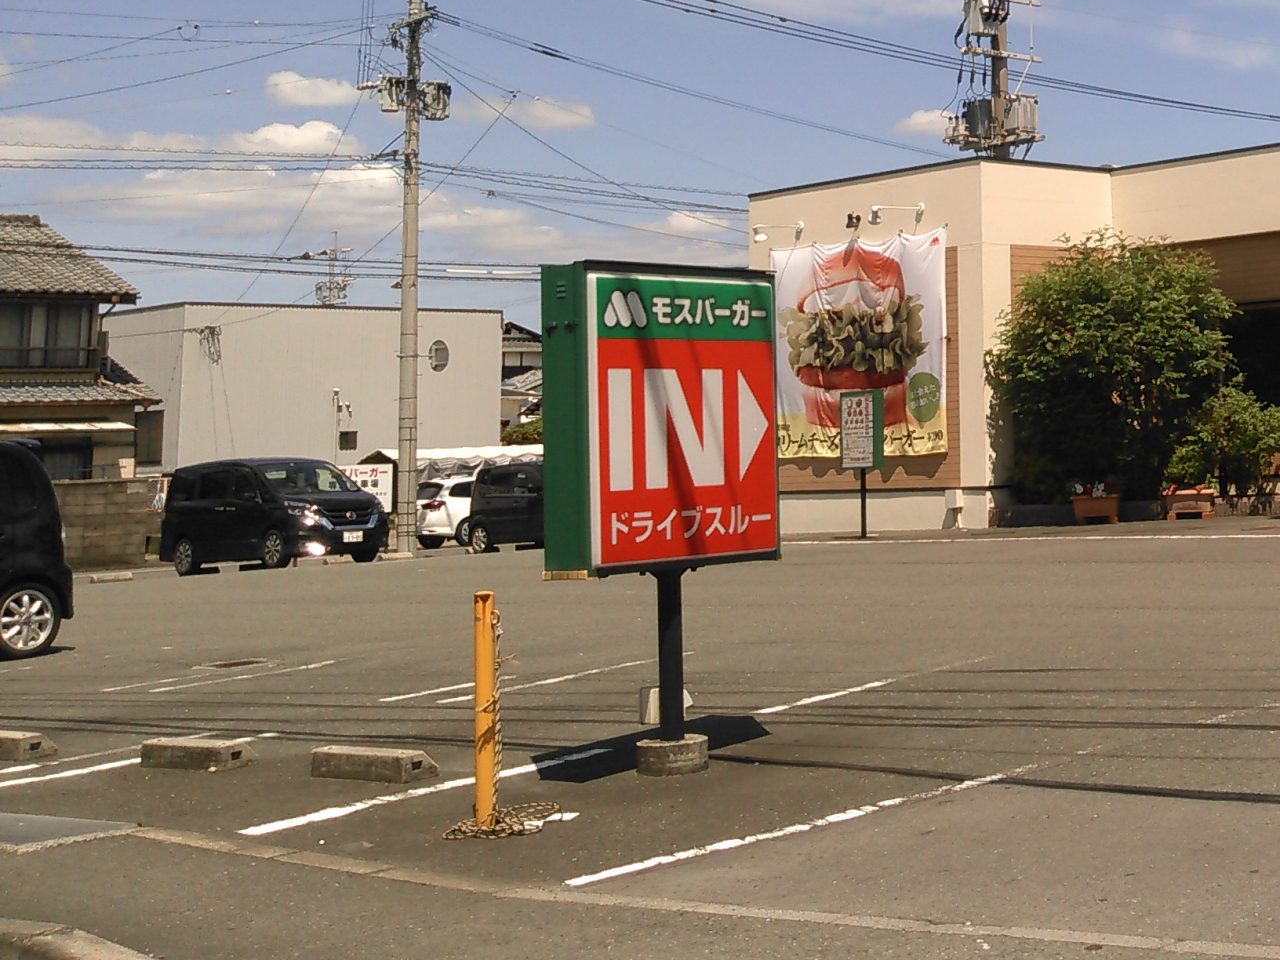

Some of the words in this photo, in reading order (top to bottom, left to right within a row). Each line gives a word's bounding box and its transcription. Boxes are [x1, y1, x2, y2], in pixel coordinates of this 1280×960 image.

[652, 296, 768, 327] モスバーガー
[607, 368, 725, 492] IN
[611, 504, 771, 545] ドライブスルー
